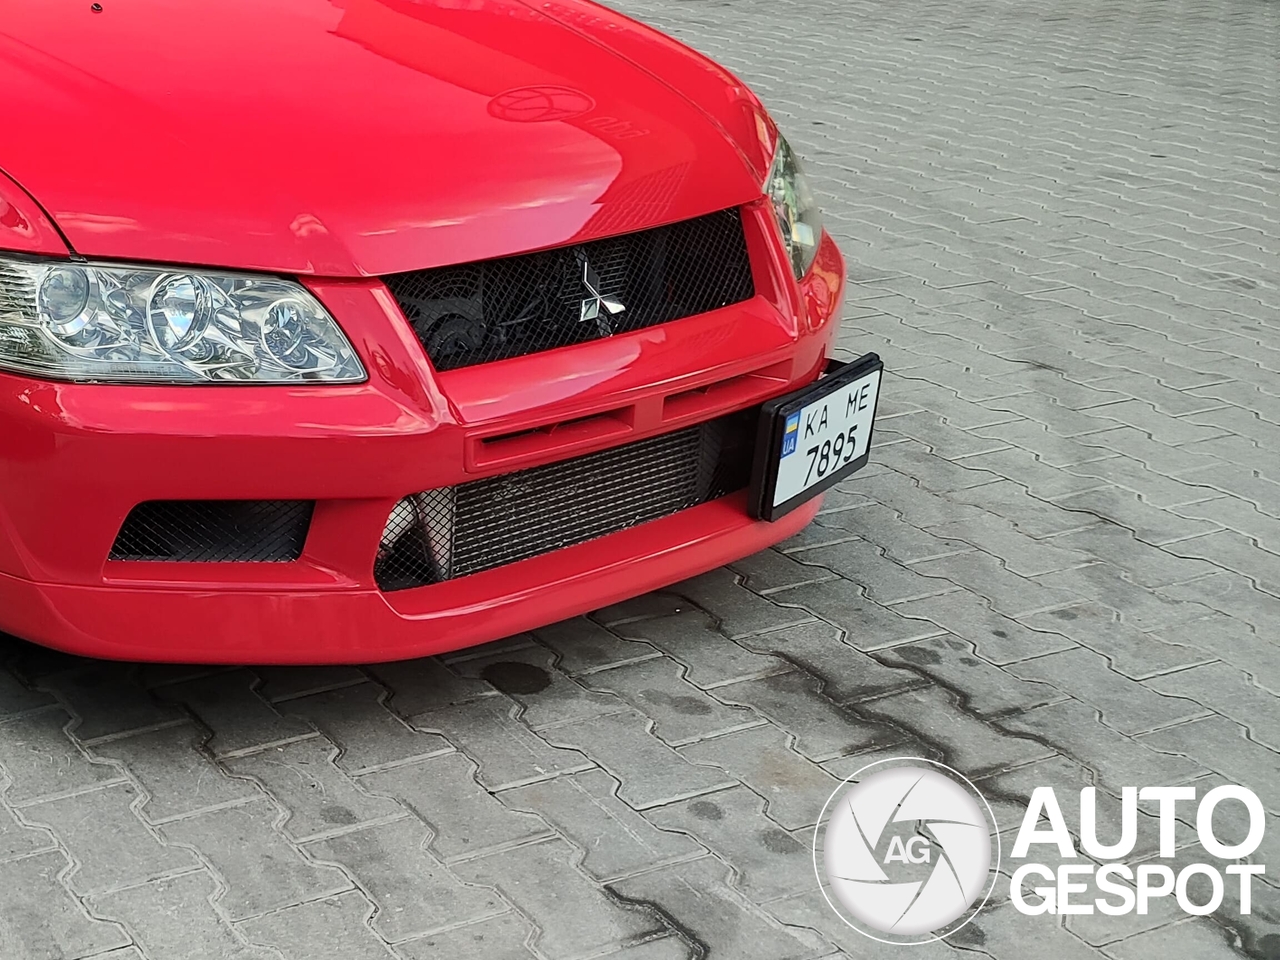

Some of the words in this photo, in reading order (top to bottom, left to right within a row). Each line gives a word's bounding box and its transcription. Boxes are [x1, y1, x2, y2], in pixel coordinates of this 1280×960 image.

[804, 404, 828, 439] KA
[845, 383, 871, 419] ME
[782, 438, 795, 455] UA
[803, 424, 858, 487] 7895
